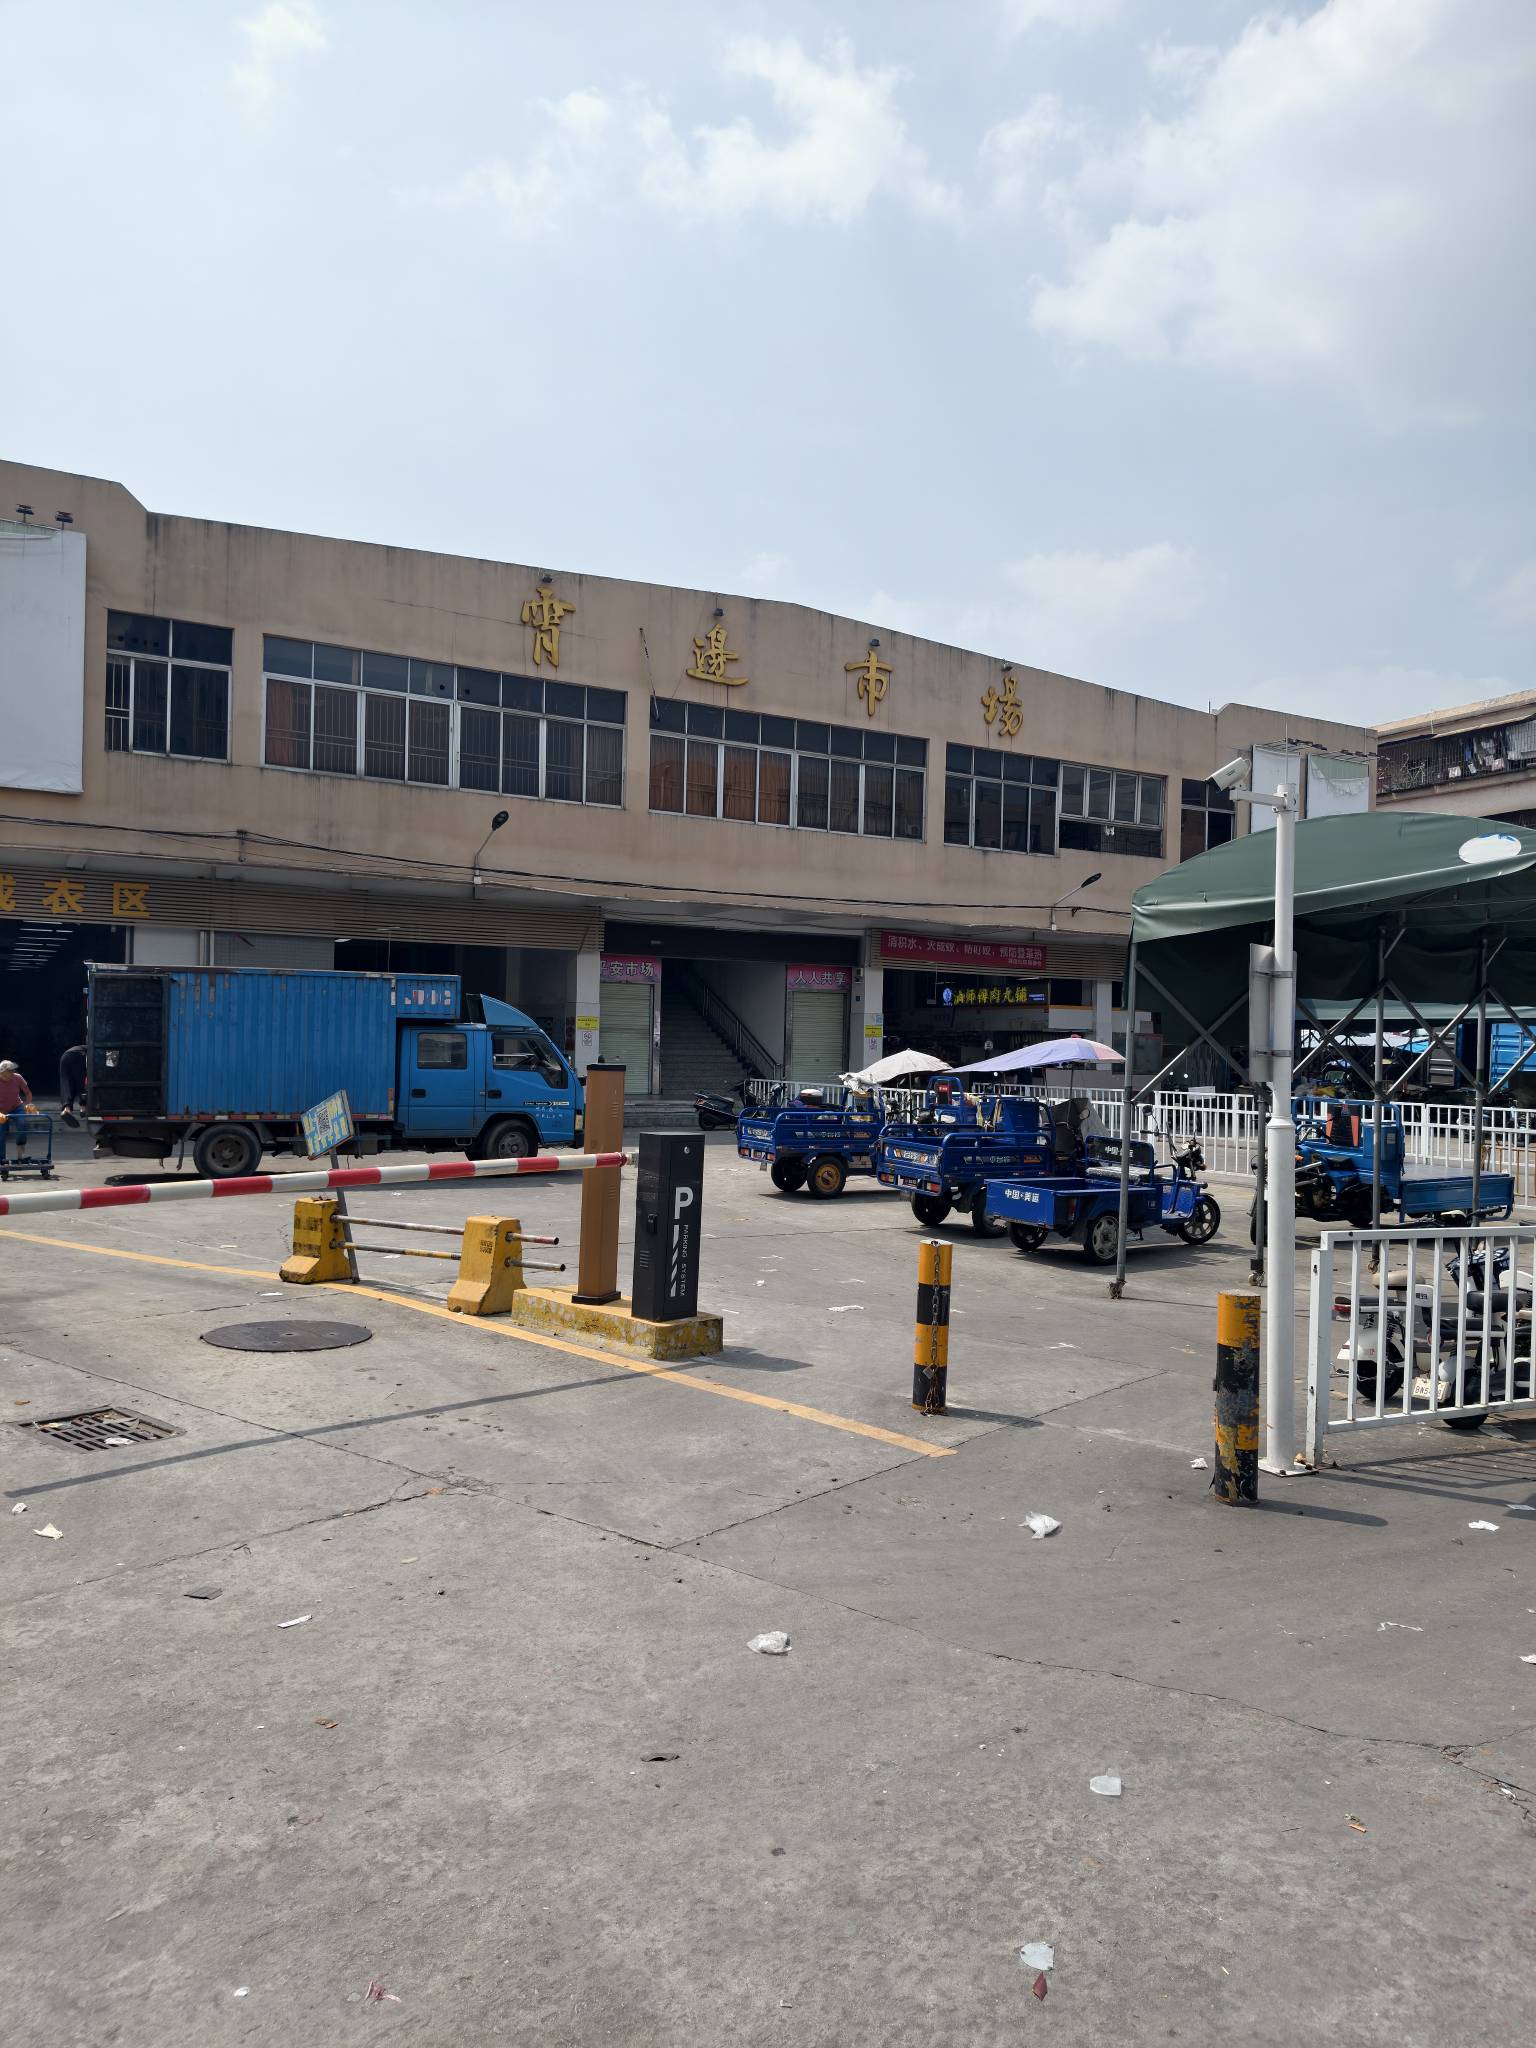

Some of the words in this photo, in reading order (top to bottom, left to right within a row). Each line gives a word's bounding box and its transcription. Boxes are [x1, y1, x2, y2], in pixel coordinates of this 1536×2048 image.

[795, 970, 847, 985] 人人共享
[680, 1263, 688, 1297] SYSTEM
